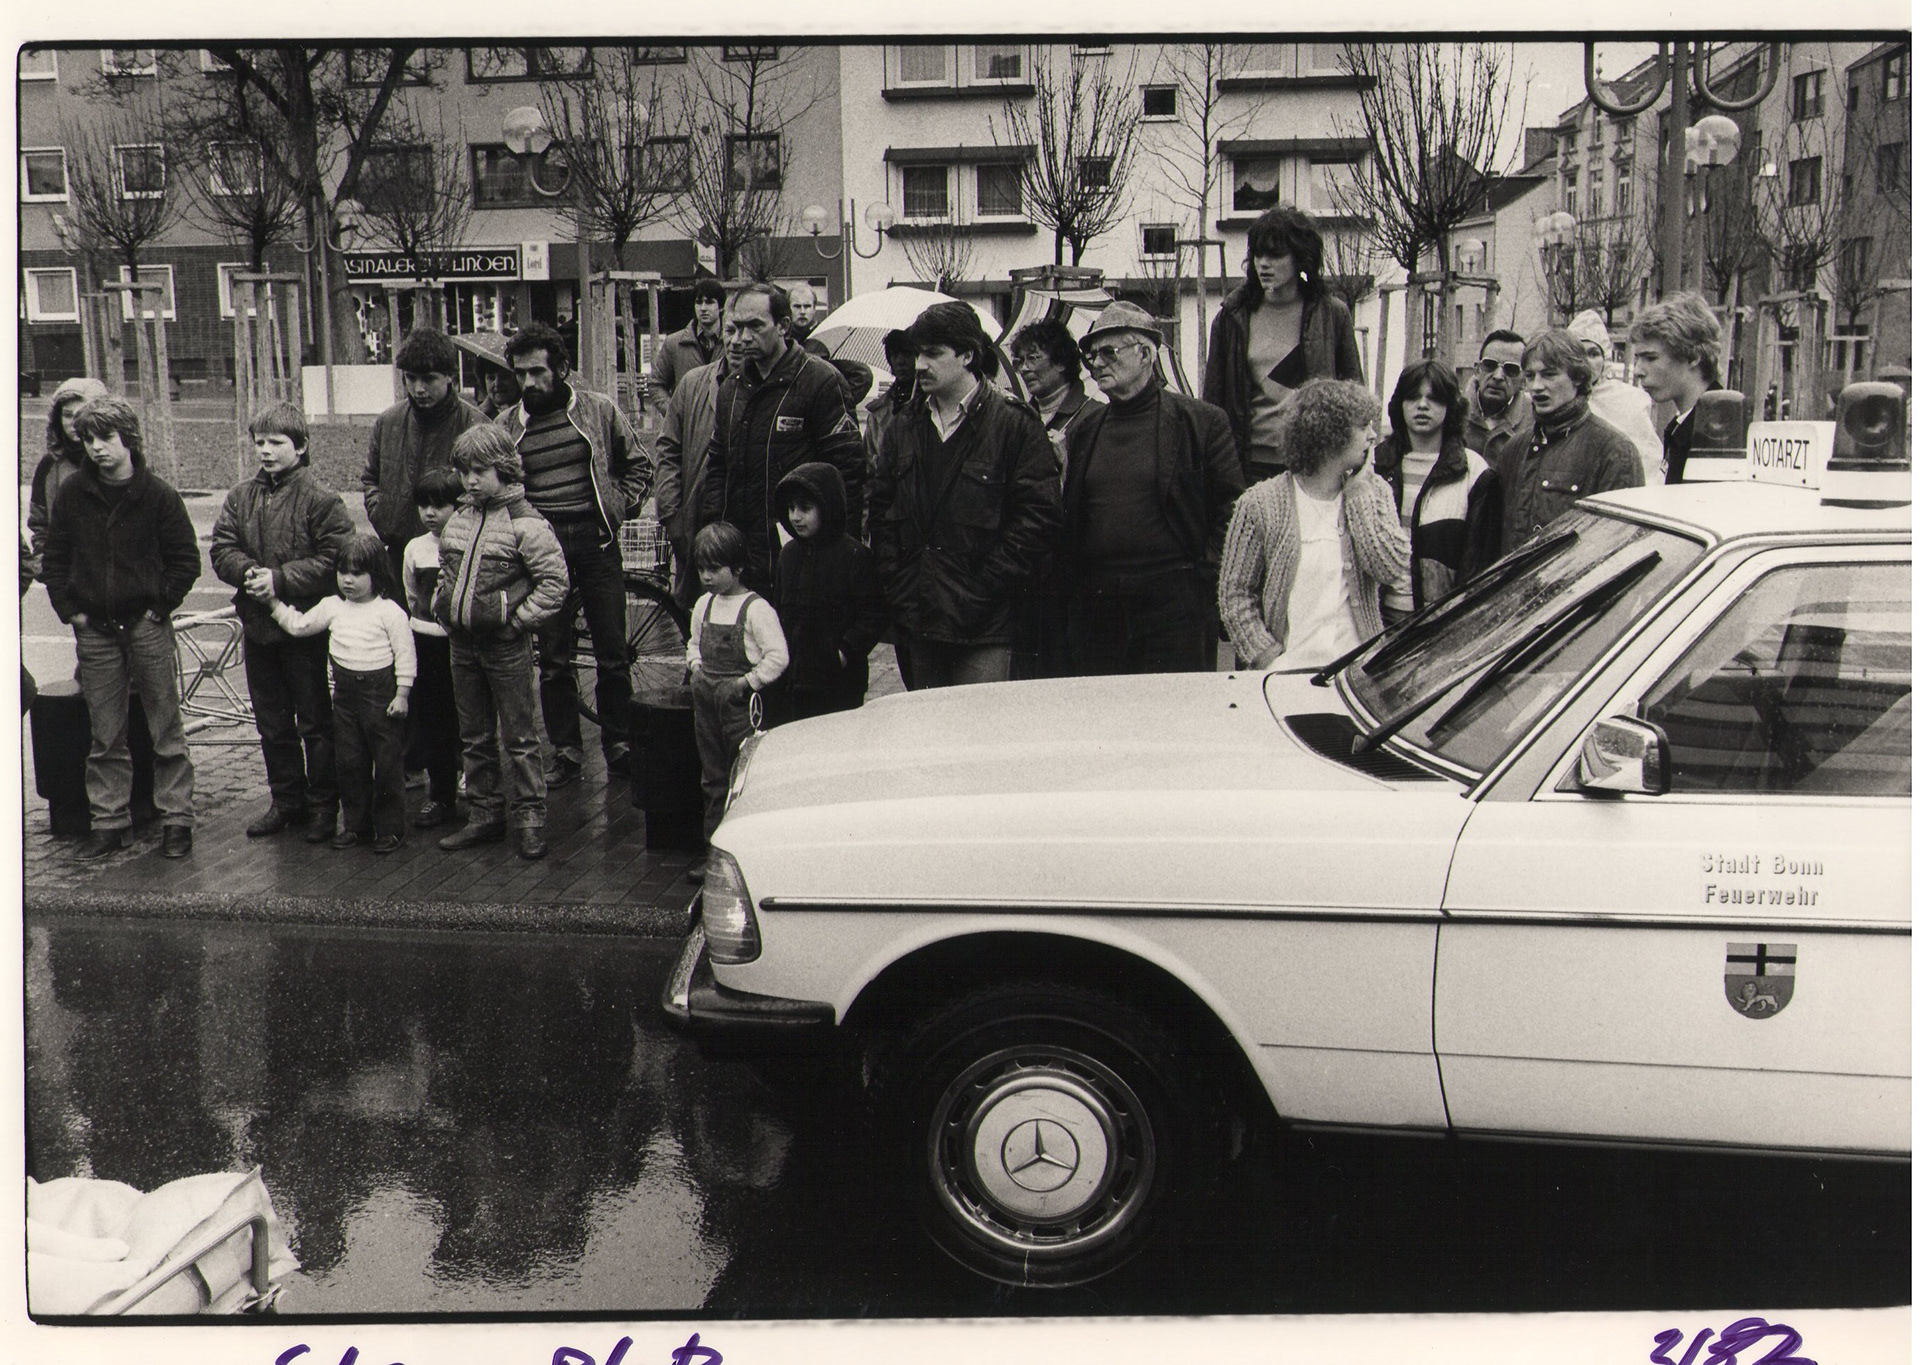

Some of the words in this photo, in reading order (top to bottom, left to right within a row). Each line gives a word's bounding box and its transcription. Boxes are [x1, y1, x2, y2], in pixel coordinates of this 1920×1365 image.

[452, 254, 517, 272] LINDEN
[1752, 437, 1810, 470] NOTARZT
[1702, 854, 1760, 874] Stadt
[1773, 854, 1824, 876] Bonn
[1704, 884, 1819, 906] Feuerwehr
